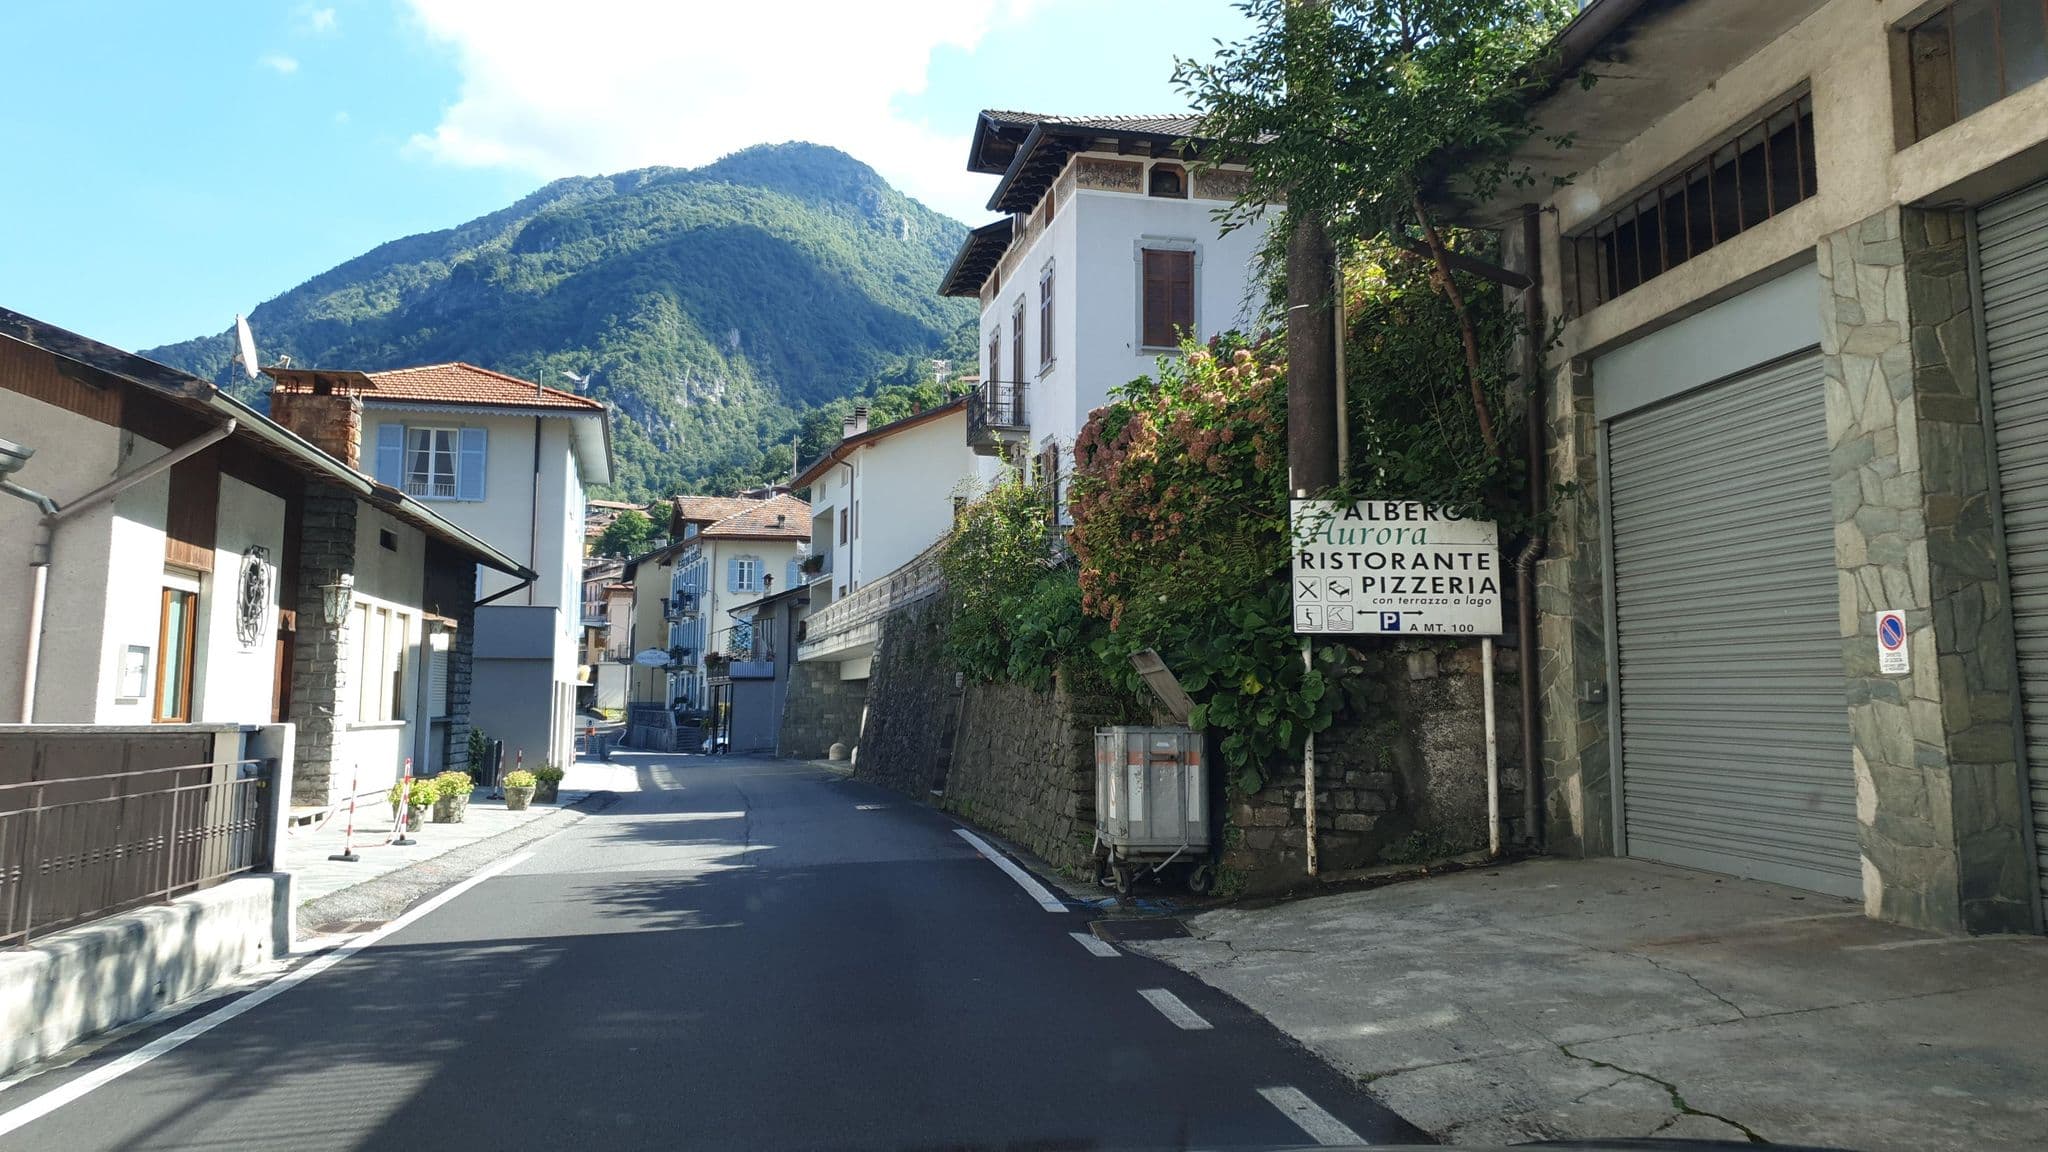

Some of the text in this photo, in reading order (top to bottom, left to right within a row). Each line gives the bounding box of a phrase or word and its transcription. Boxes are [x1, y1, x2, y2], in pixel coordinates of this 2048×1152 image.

[1296, 514, 1428, 546] Aurora
[1301, 552, 1490, 570] RISTORANTE
[1362, 576, 1497, 594] PIZZERIA
[1373, 597, 1393, 605] con
[1399, 596, 1448, 605] terrazza
[1465, 595, 1492, 607] lago
[1383, 613, 1474, 633] P A MT. 100
